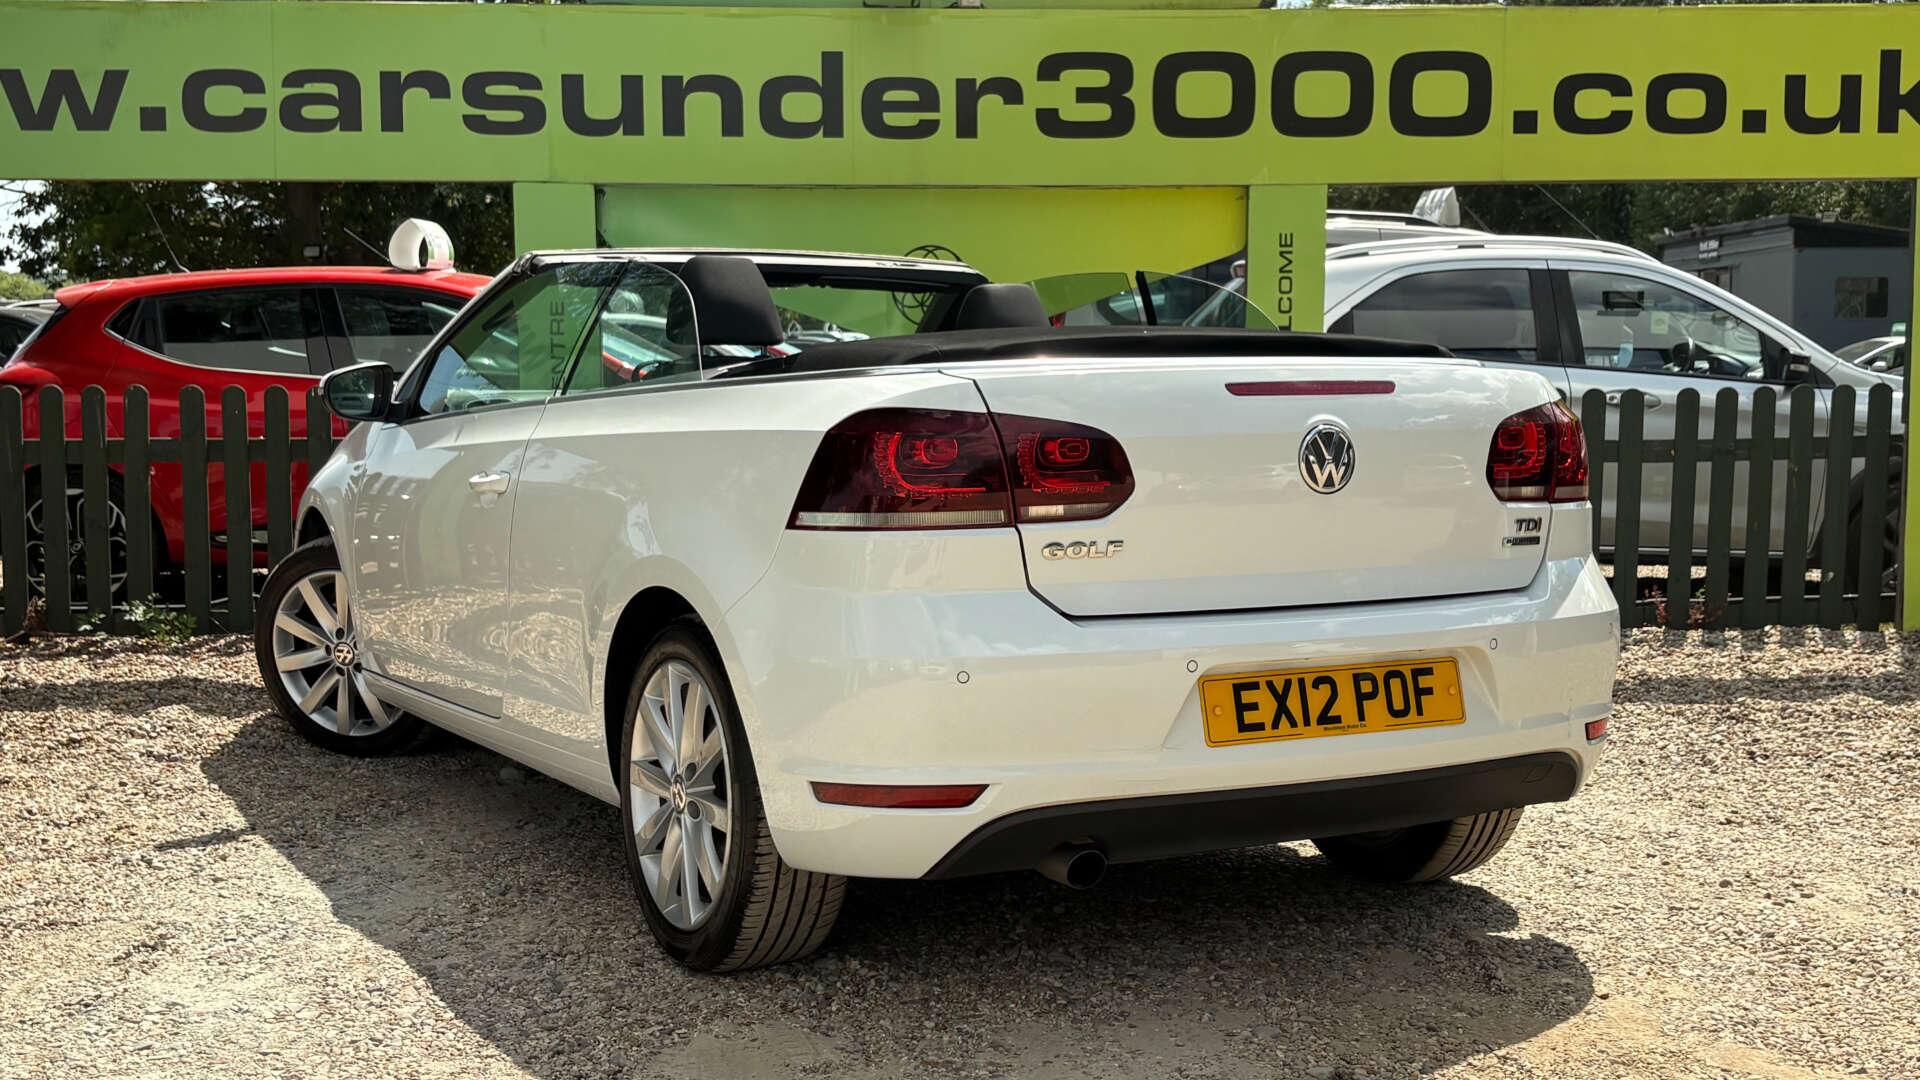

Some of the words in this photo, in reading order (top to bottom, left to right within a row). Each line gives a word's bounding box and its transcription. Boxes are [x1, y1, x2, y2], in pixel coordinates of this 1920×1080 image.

[1514, 516, 1542, 534] TDI
[1041, 540, 1124, 561] GOLF
[1232, 675, 1342, 734] EX12
[1352, 666, 1435, 722] POF
